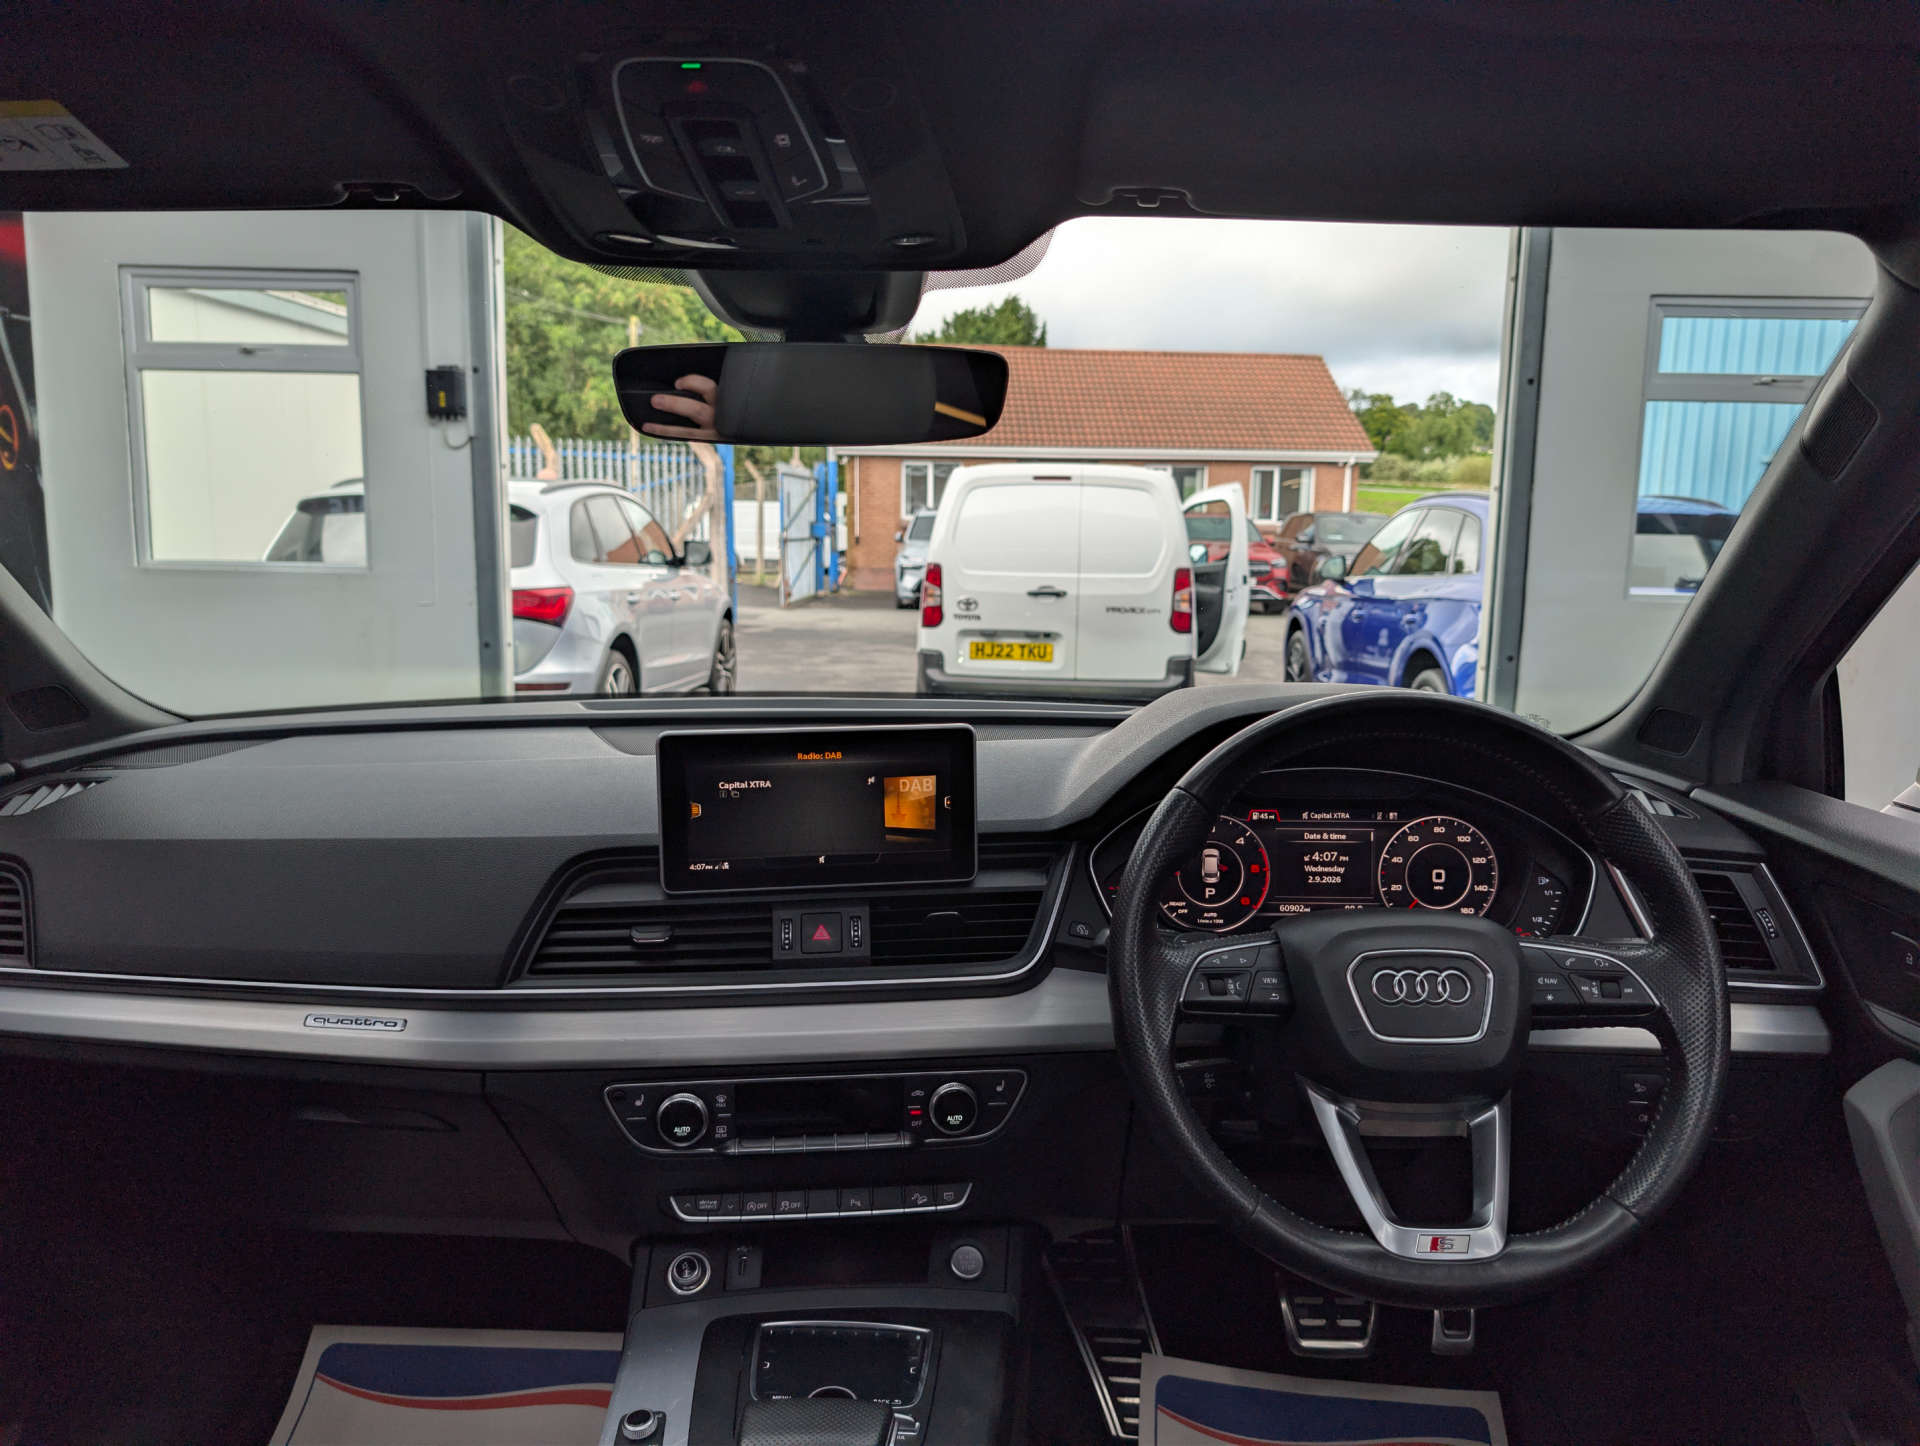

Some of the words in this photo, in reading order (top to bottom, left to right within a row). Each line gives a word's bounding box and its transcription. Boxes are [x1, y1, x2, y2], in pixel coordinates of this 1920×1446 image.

[953, 613, 981, 621] TOYOTA
[975, 642, 1015, 658] HJ22
[1019, 643, 1048, 659] TKU
[797, 752, 823, 760] Radio:
[824, 751, 842, 760] DAB
[718, 780, 748, 791] Capital
[749, 779, 772, 789] XTRA
[899, 777, 933, 793] DAB
[1310, 811, 1332, 821] Capital
[1333, 811, 1350, 820] XTRA
[1433, 826, 1446, 834] 80
[1303, 832, 1321, 840] Date
[1322, 832, 1329, 840] &
[1329, 832, 1346, 840] time
[1407, 835, 1420, 843] 60
[1456, 835, 1471, 843] 100
[1234, 836, 1245, 846] 4
[1311, 850, 1338, 862] 4:07
[1391, 856, 1403, 864] 40
[1472, 856, 1487, 865] 120
[1303, 864, 1345, 875] Wednesday
[1307, 874, 1342, 884] 2.9.2026
[1432, 868, 1446, 884] 0
[1390, 884, 1403, 892] 20
[1473, 884, 1489, 892] 140
[1205, 887, 1216, 899] P
[1459, 907, 1475, 916] 160
[1544, 977, 1558, 985] NAV
[312, 1016, 398, 1028] quattro
[672, 1125, 691, 1133] AUTO
[790, 1201, 801, 1209] OFF
